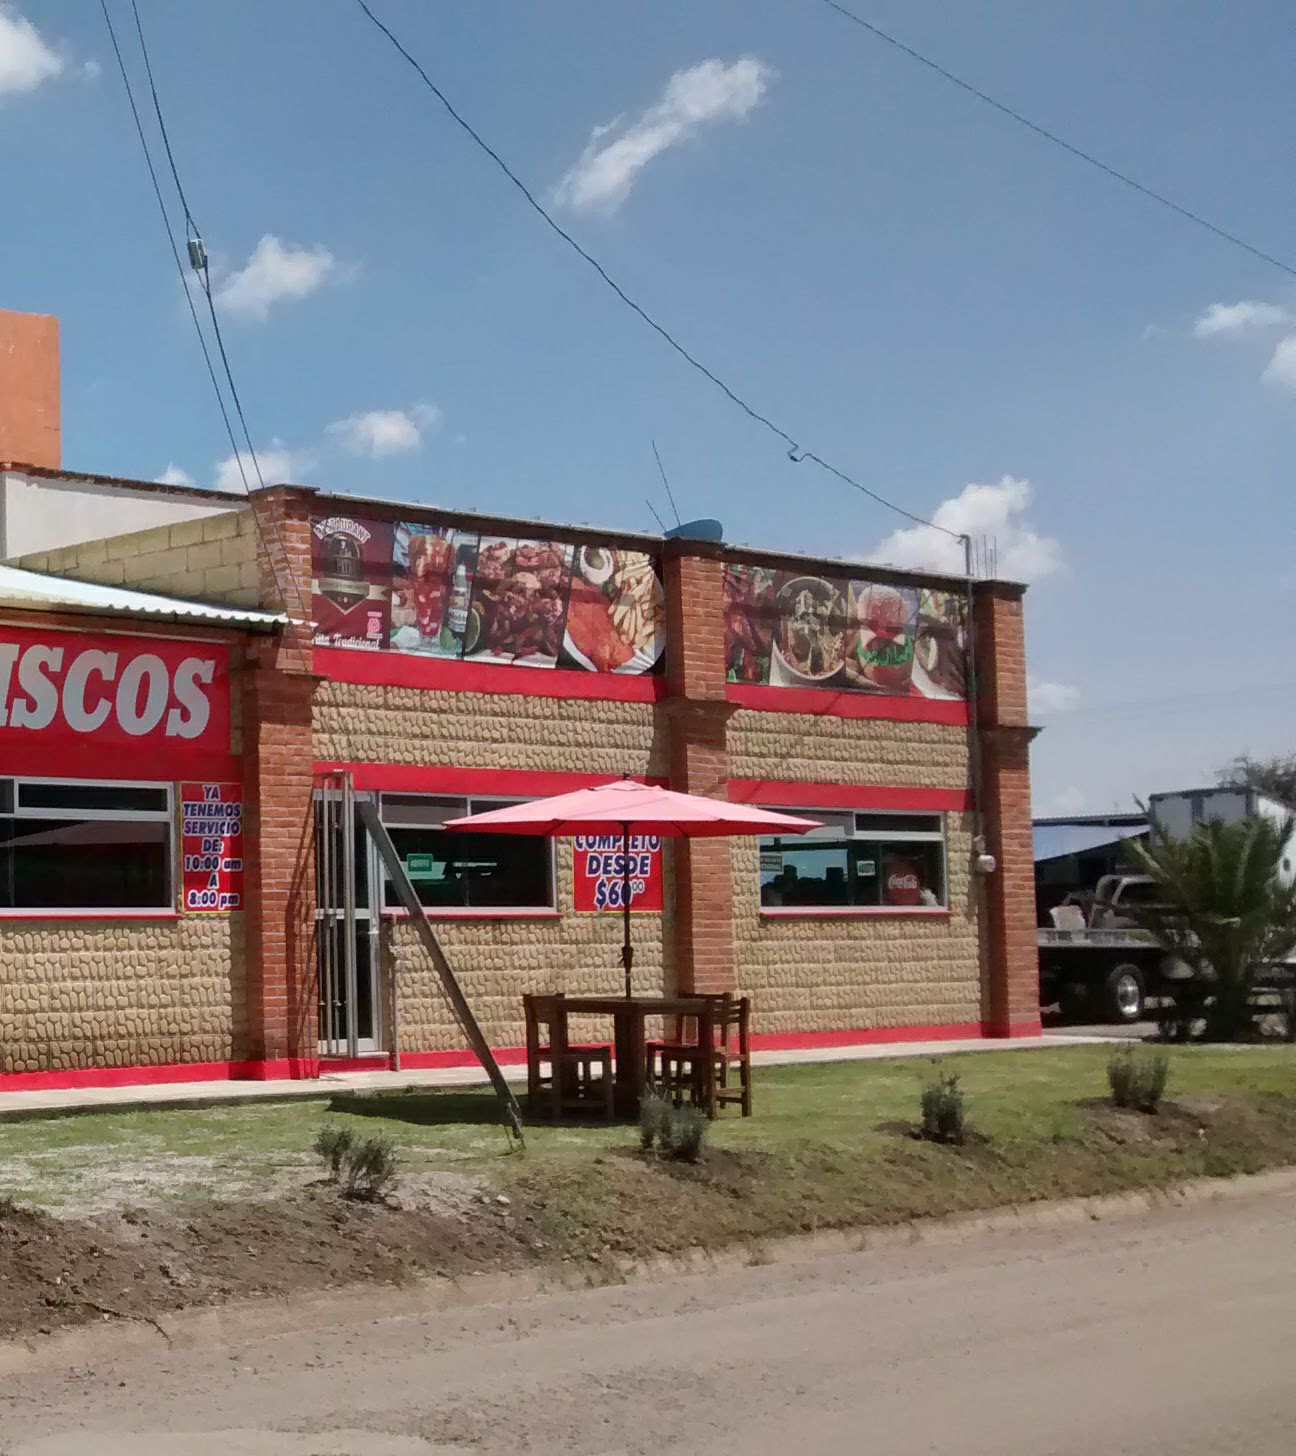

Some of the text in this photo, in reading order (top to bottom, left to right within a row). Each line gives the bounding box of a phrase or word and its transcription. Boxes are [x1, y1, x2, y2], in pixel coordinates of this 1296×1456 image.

[203, 785, 221, 800] YA
[184, 803, 242, 817] TENEMOS
[184, 820, 241, 835] SERVICIO
[202, 838, 223, 853] DE:
[574, 835, 660, 851] COMPETO
[185, 856, 242, 871] 10:00 am
[586, 853, 651, 877] DESDE
[208, 873, 219, 888] A
[189, 891, 240, 909] 8:00 pm
